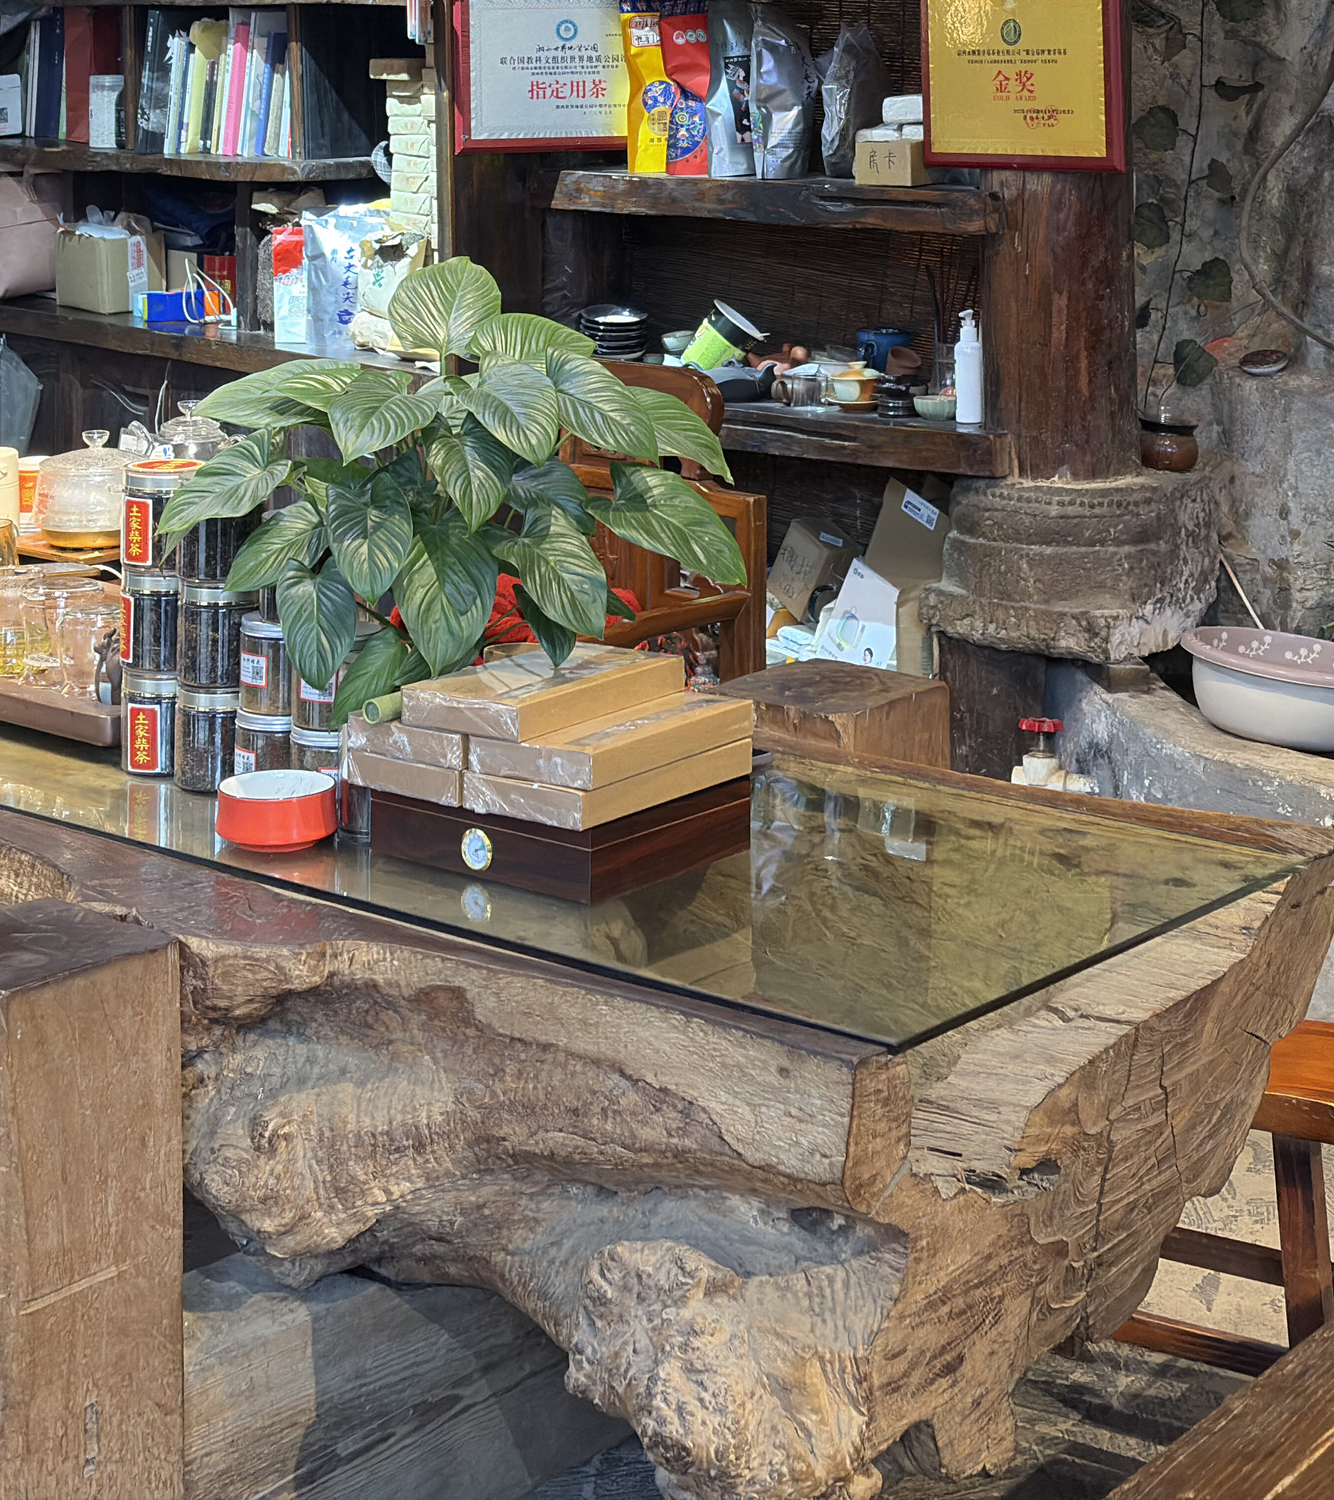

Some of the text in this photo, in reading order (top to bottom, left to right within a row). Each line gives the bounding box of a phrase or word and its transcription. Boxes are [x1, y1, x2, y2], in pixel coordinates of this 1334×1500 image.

[527, 78, 609, 100] 指定用茶
[991, 69, 1036, 95] 金奖
[128, 503, 143, 558] 土家柴茶
[134, 711, 151, 765] 土家柴茶
